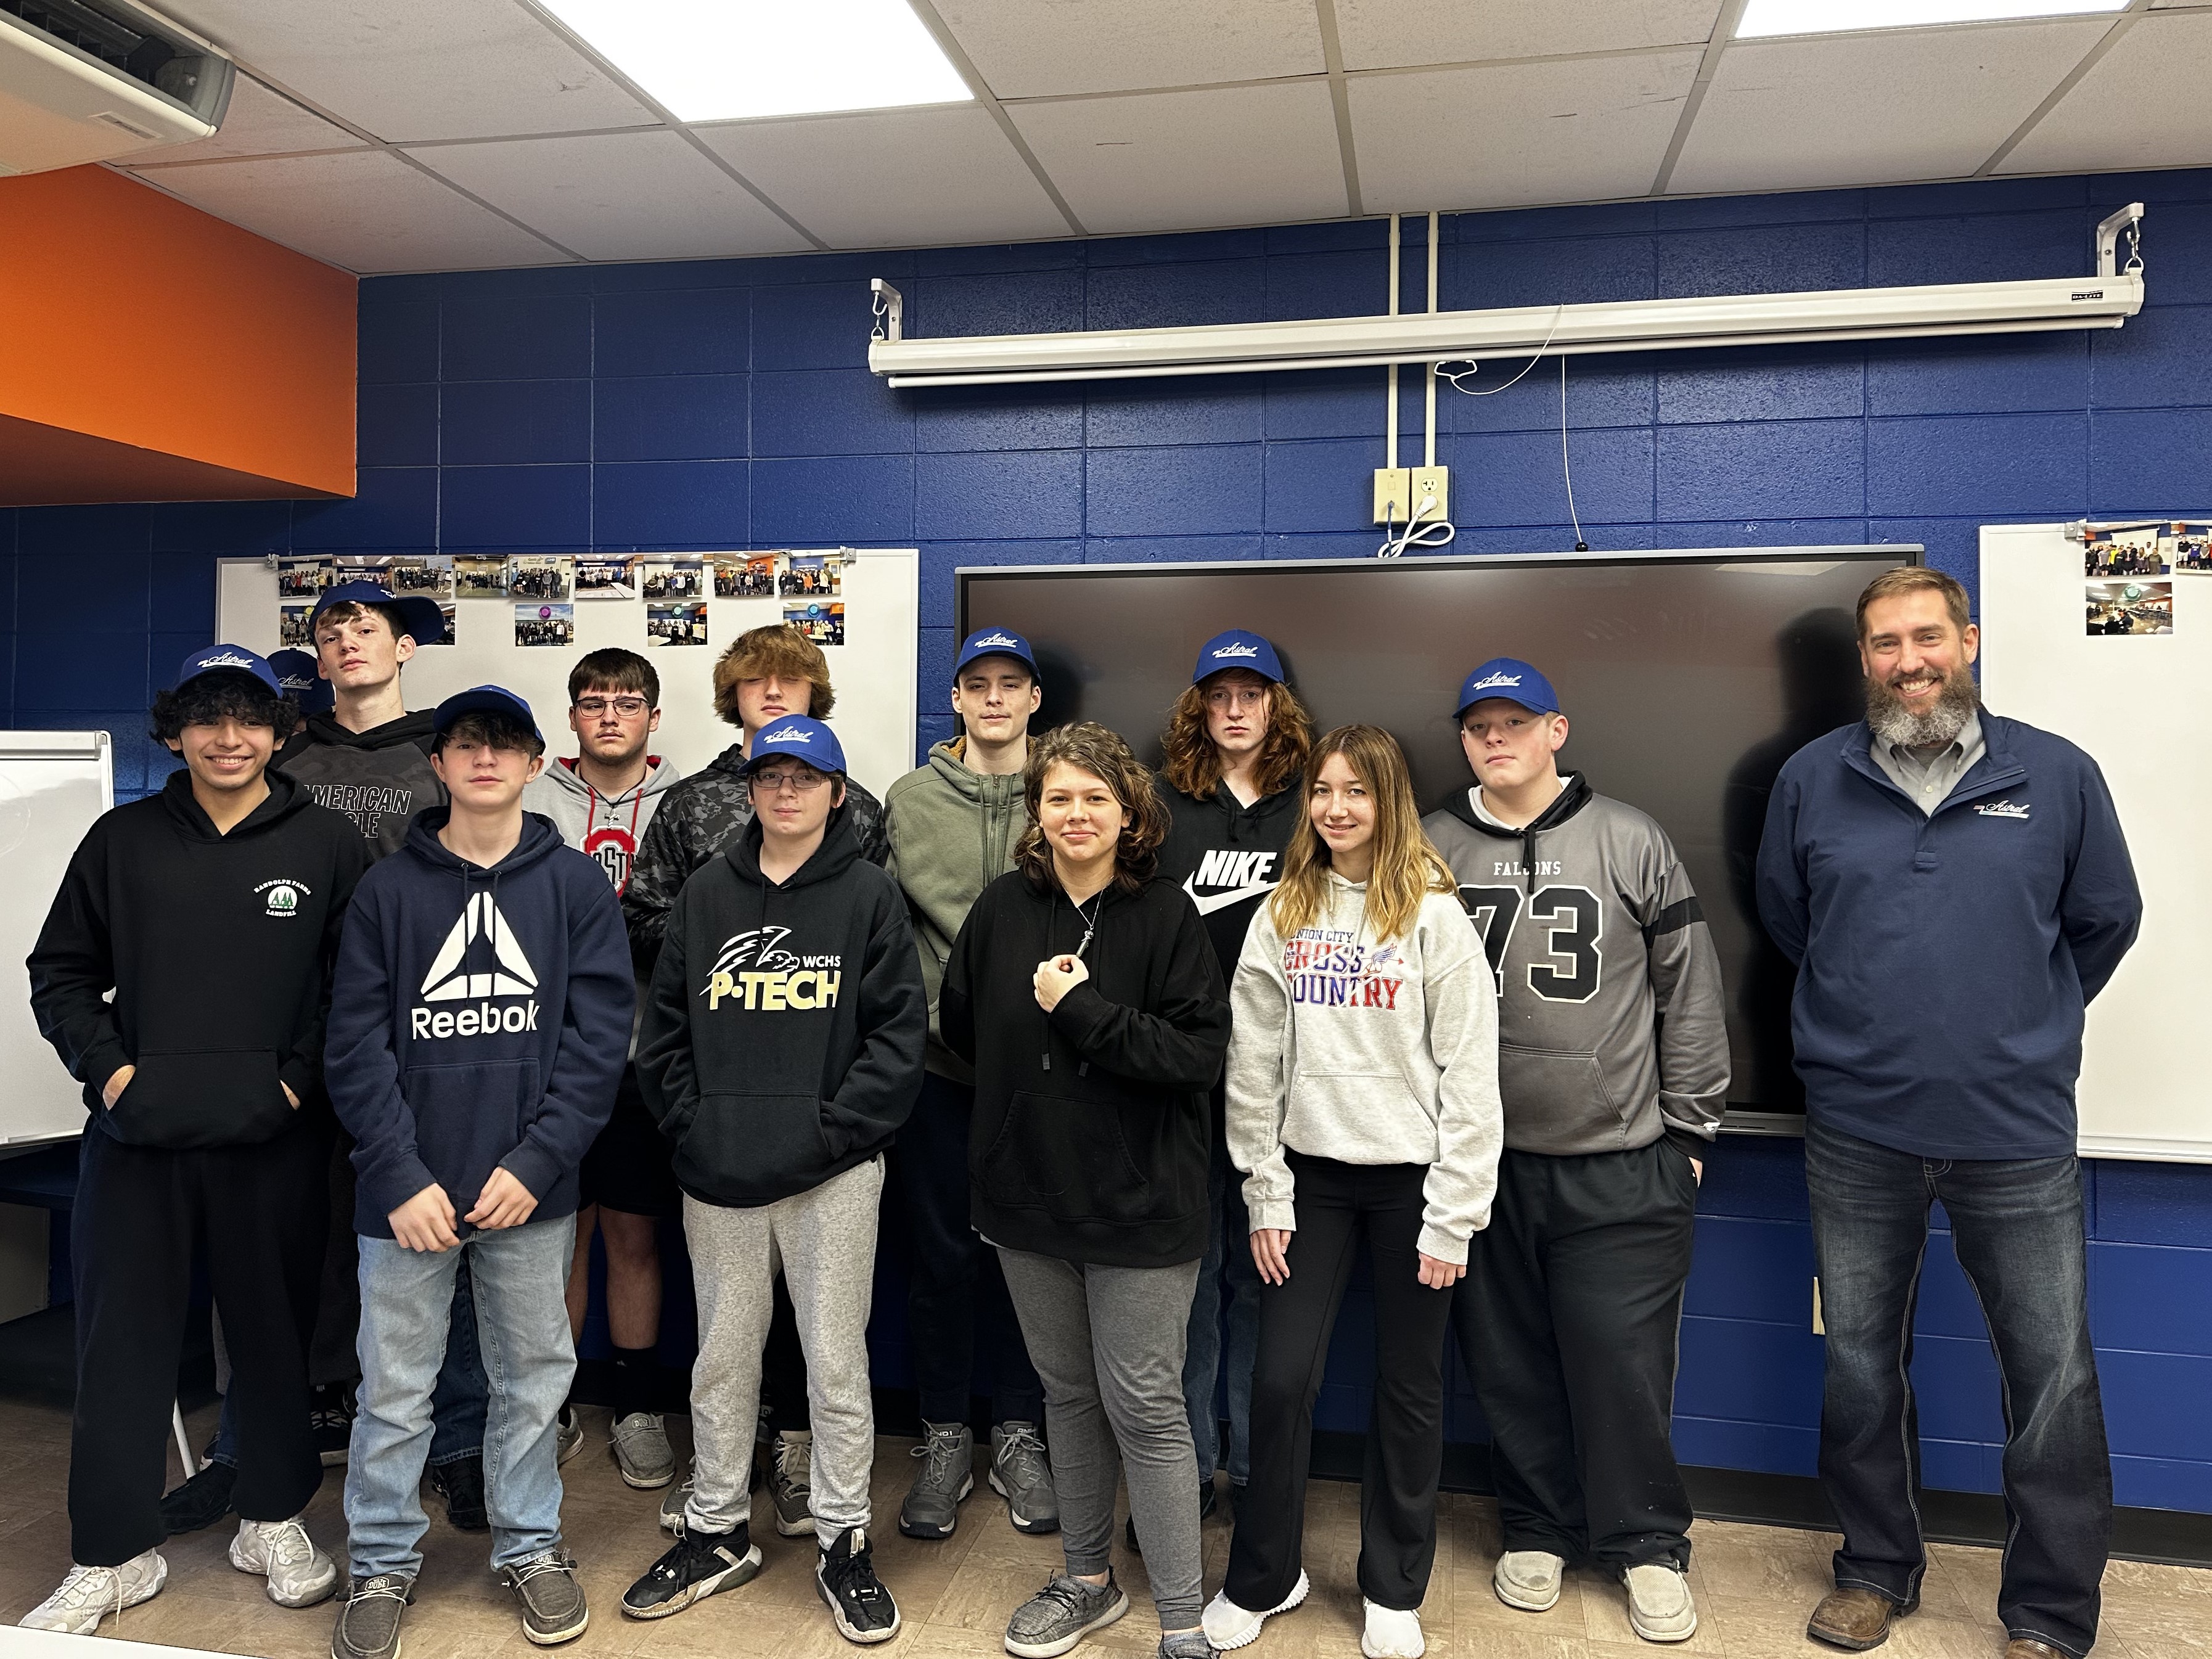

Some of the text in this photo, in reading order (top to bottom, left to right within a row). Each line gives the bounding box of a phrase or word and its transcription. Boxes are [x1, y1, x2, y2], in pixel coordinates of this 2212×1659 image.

[1220, 642, 1258, 653] Astral
[208, 652, 253, 665] Astral
[278, 674, 314, 686] Astral
[1481, 671, 1522, 684] Astral
[772, 726, 814, 739] Astral
[304, 784, 412, 814] MERICAN
[1986, 800, 2030, 813] Astral
[1195, 850, 1277, 887] NIKE
[1291, 929, 1354, 943] NION CITY
[1457, 884, 1602, 1004] 73
[803, 955, 841, 968] WCHS
[1284, 940, 1366, 975] CROSS
[411, 999, 540, 1040] Reebok
